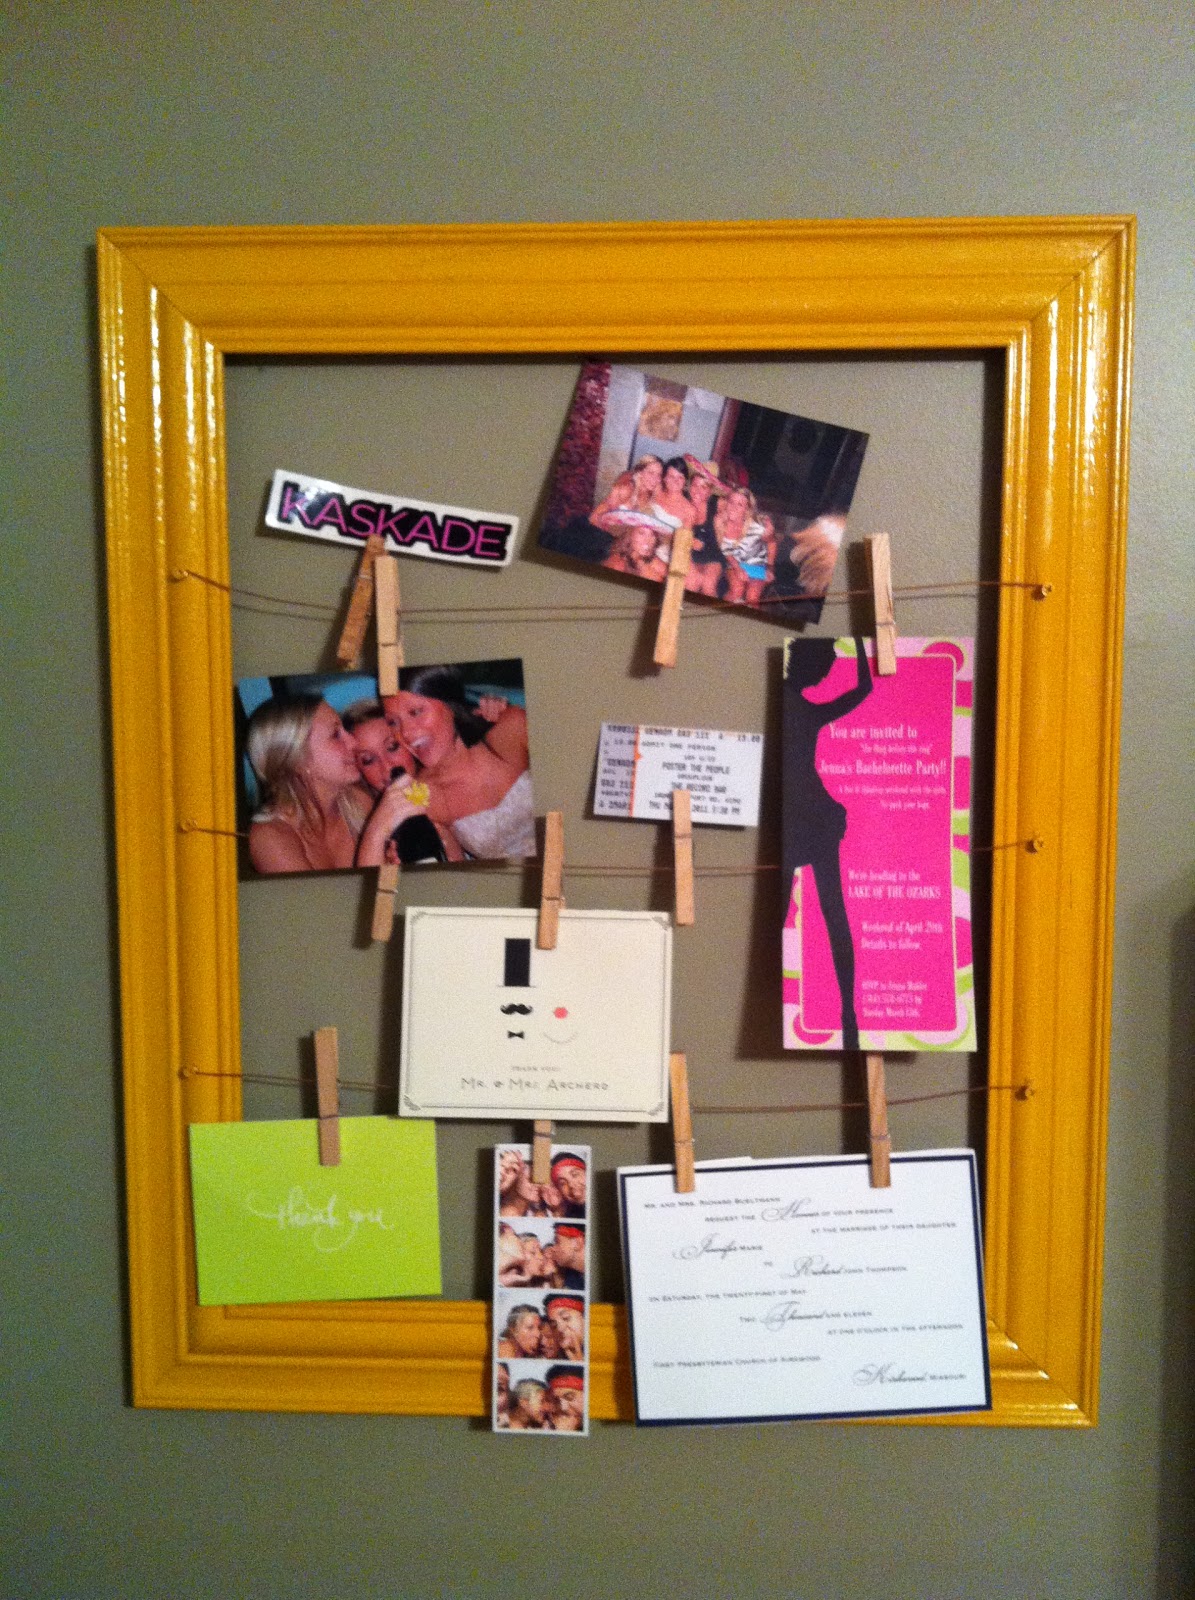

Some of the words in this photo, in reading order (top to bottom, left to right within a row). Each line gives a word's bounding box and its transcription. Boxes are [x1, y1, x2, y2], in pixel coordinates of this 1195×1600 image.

[278, 483, 511, 560] KASKADE
[830, 722, 847, 738] You
[850, 727, 866, 738] are
[870, 724, 904, 738] invited
[908, 726, 917, 738] to
[819, 760, 851, 774] Jenna's
[856, 760, 912, 774] Bachelorette
[908, 870, 920, 881] the
[848, 885, 870, 898] LAKE
[873, 886, 884, 898] OF
[888, 886, 902, 898] THE
[906, 886, 940, 899] OZARKS
